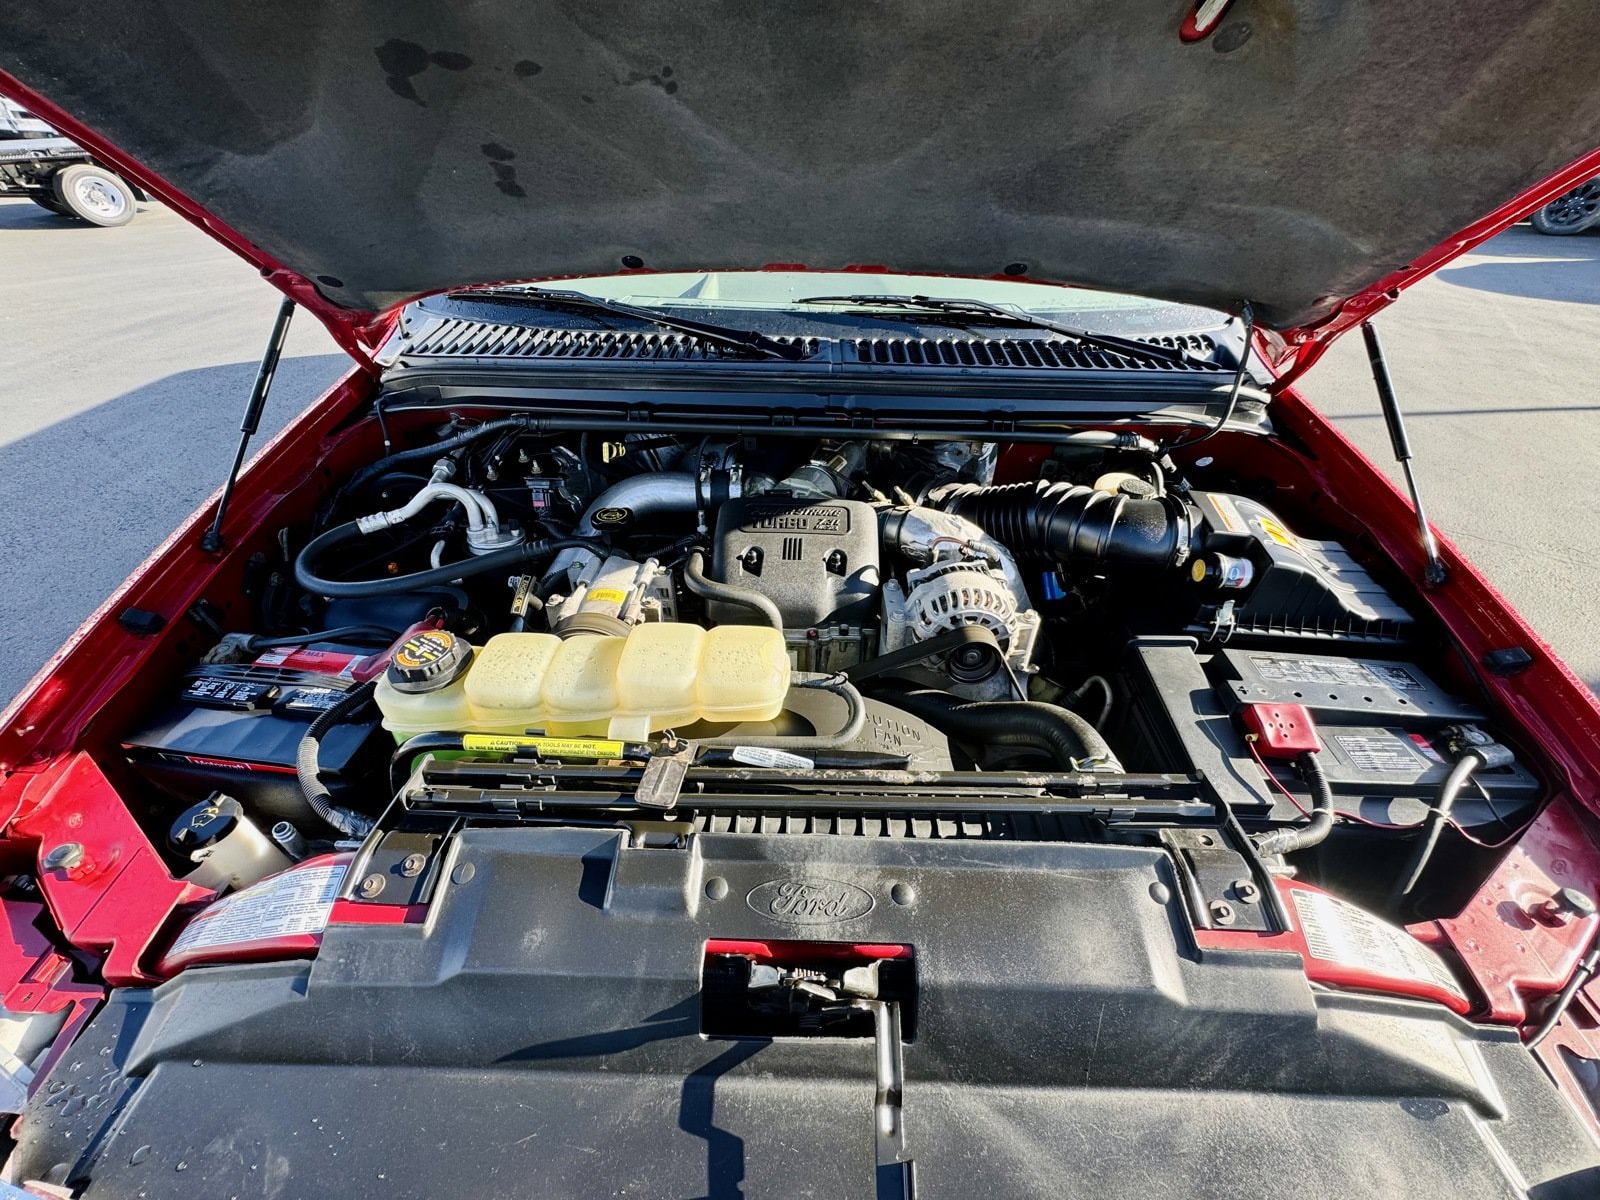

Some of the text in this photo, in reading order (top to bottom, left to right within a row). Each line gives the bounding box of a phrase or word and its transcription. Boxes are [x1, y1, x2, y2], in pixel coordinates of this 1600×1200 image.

[752, 517, 809, 529] TURBO
[865, 713, 921, 742] AUTION
[874, 728, 902, 746] FAN
[769, 882, 849, 917] Ford
